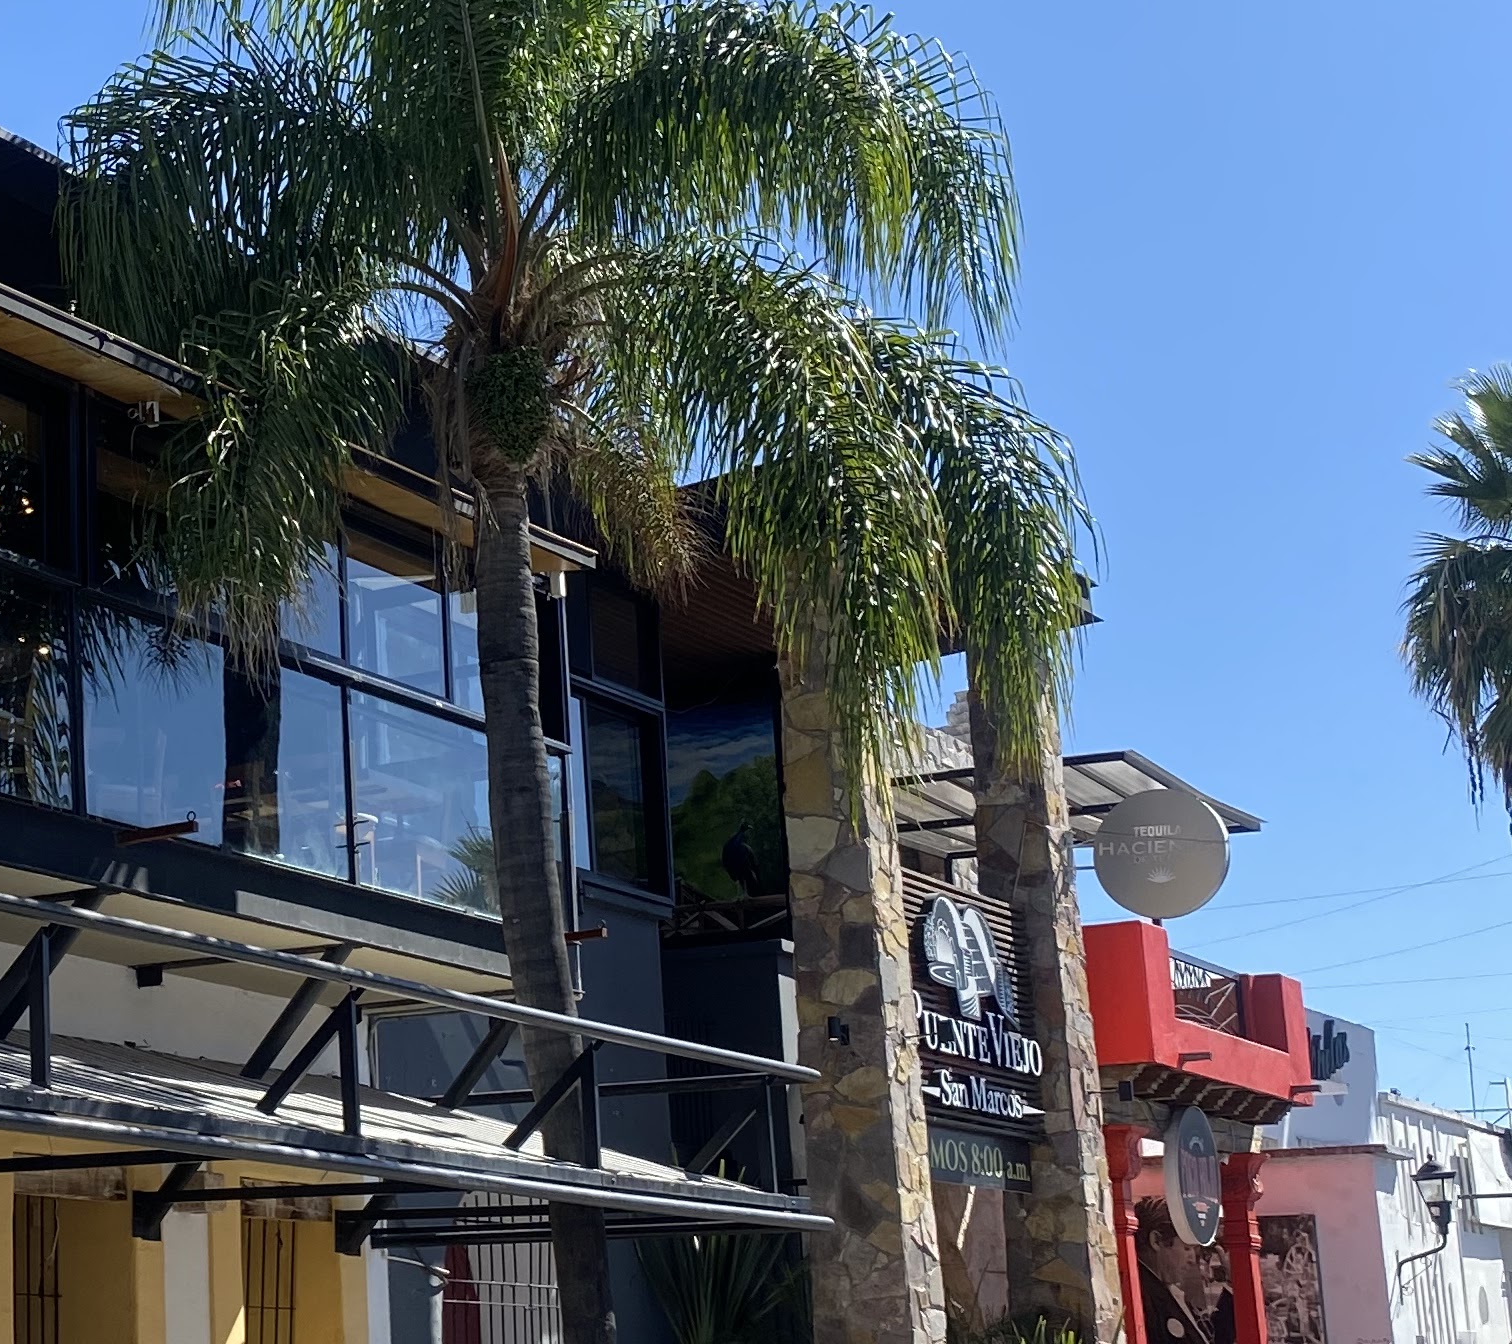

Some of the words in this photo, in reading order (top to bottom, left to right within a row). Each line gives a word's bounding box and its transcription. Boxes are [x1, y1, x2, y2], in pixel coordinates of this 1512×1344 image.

[1133, 825, 1181, 837] TEQUILA
[986, 1010, 1043, 1077] VIEJO
[941, 1068, 970, 1109] San
[970, 1076, 1024, 1119] Marcos
[972, 1143, 1003, 1178] 8:00
[1007, 1161, 1031, 1182] a.m.
